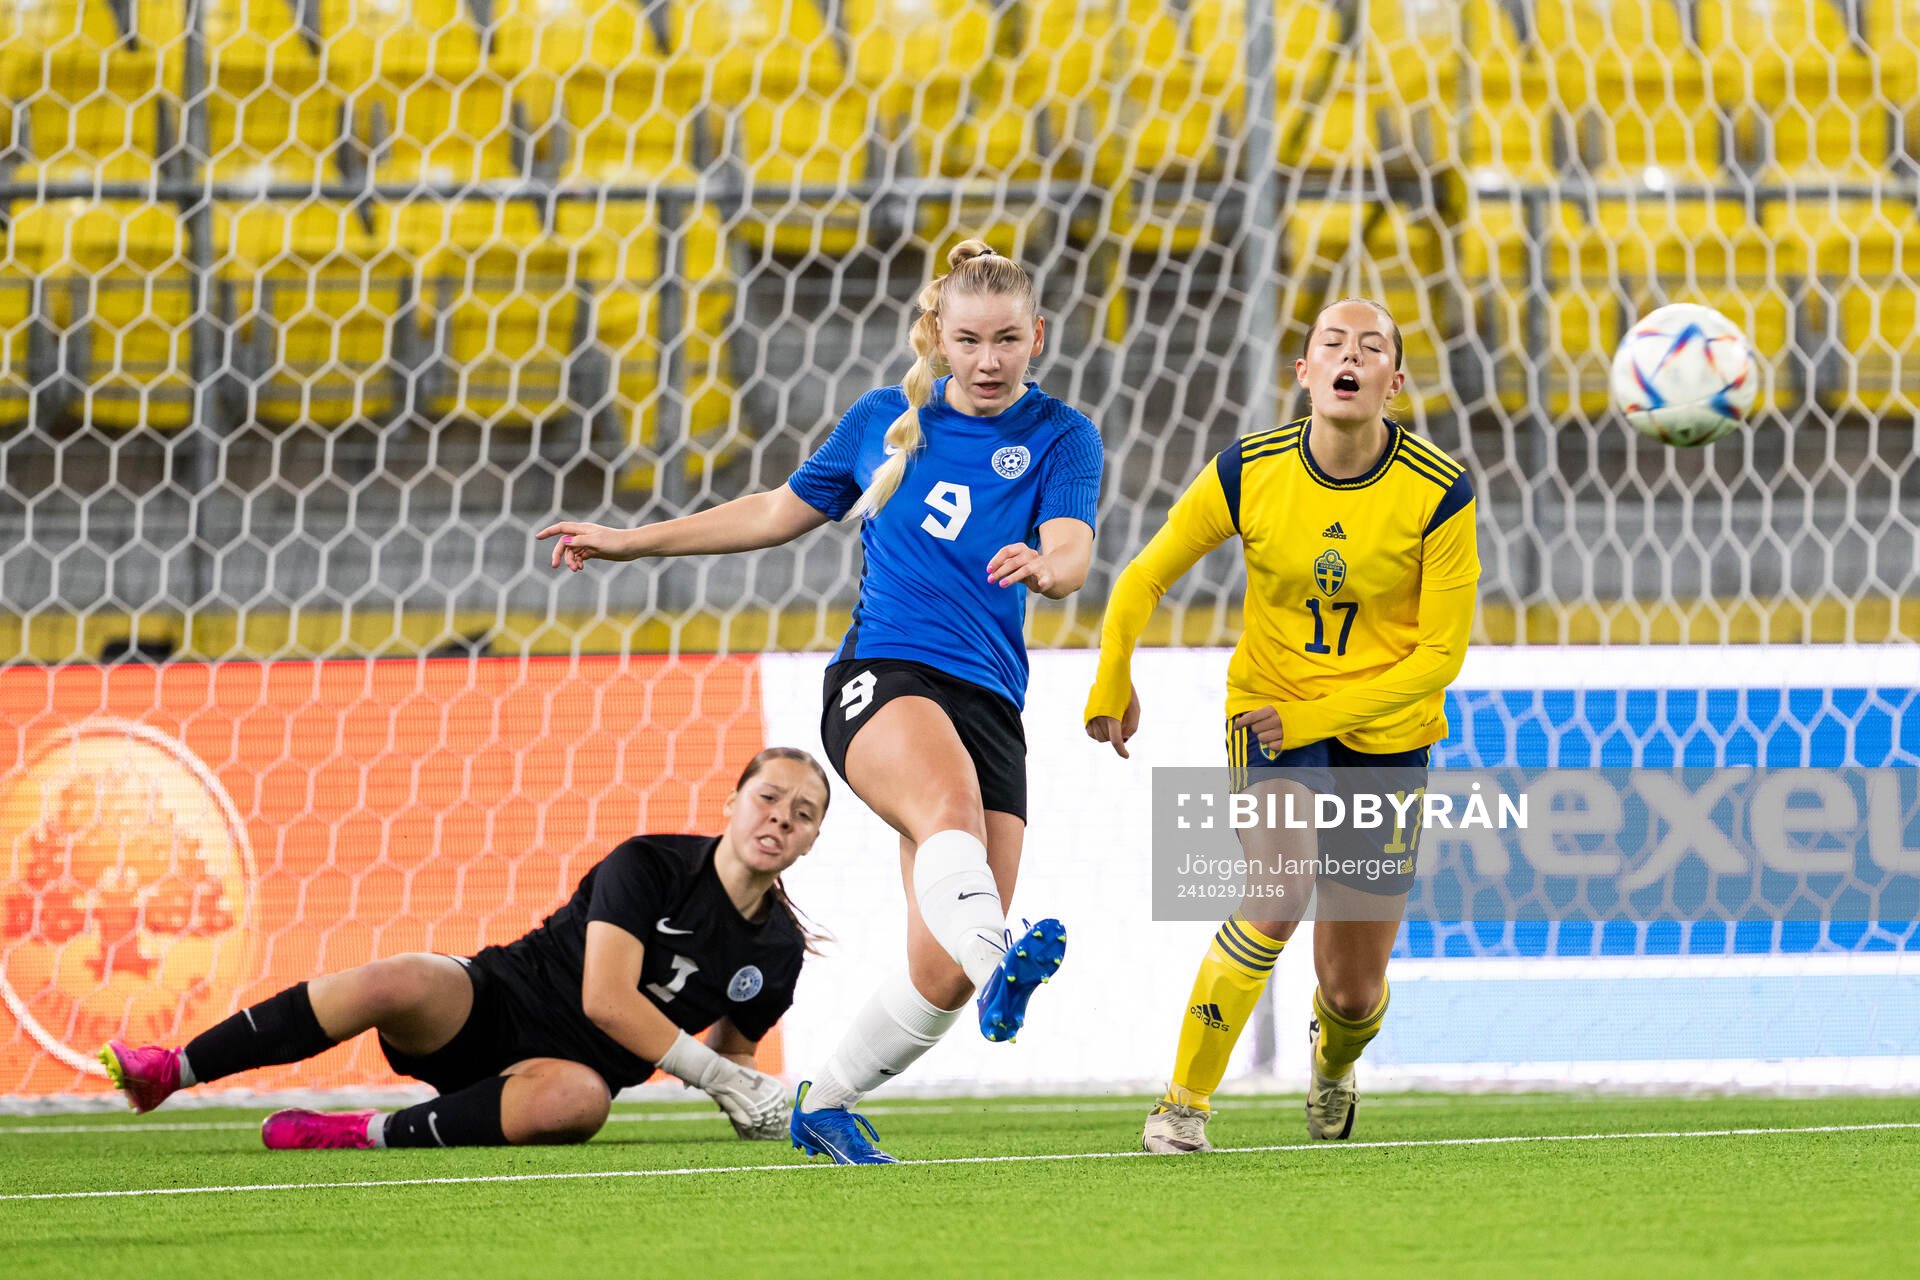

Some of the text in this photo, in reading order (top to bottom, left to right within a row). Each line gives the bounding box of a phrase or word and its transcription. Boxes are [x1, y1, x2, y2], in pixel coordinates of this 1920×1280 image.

[921, 481, 972, 541] 9
[1322, 531, 1347, 540] adidas
[1305, 598, 1359, 656] 17
[840, 670, 878, 721] 9
[646, 954, 699, 1003] 1
[1190, 1006, 1230, 1032] adidas
